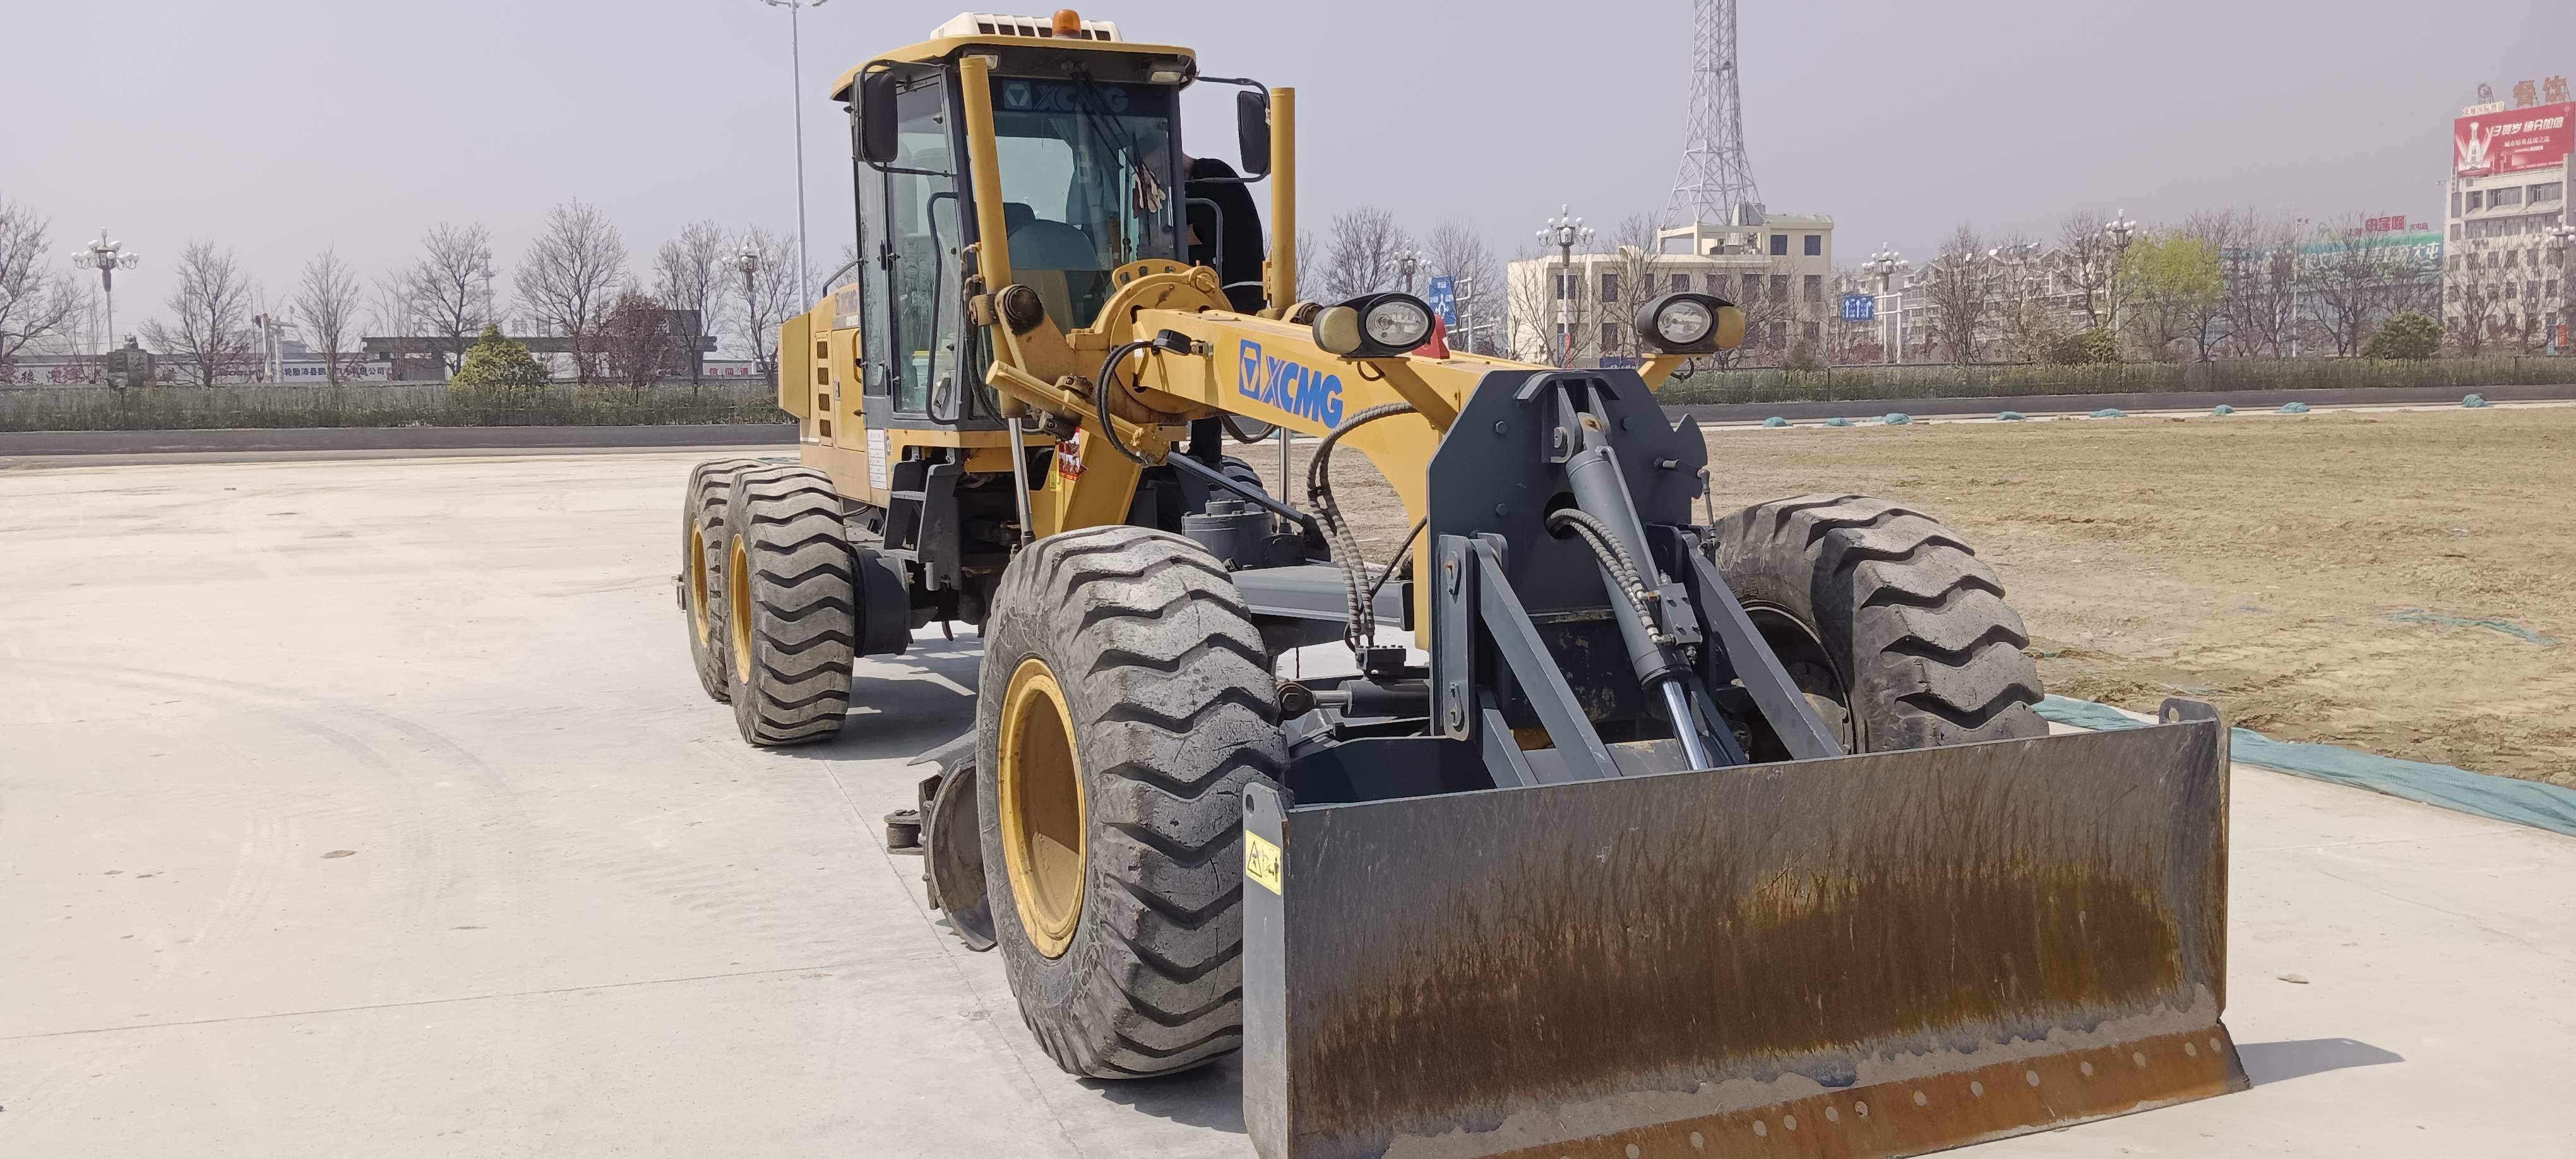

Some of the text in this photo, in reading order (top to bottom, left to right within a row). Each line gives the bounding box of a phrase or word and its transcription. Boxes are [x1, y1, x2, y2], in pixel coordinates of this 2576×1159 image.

[1033, 85, 1129, 113] XCMG
[2513, 75, 2567, 107] 餐饮
[1261, 354, 1344, 429] XCMG
